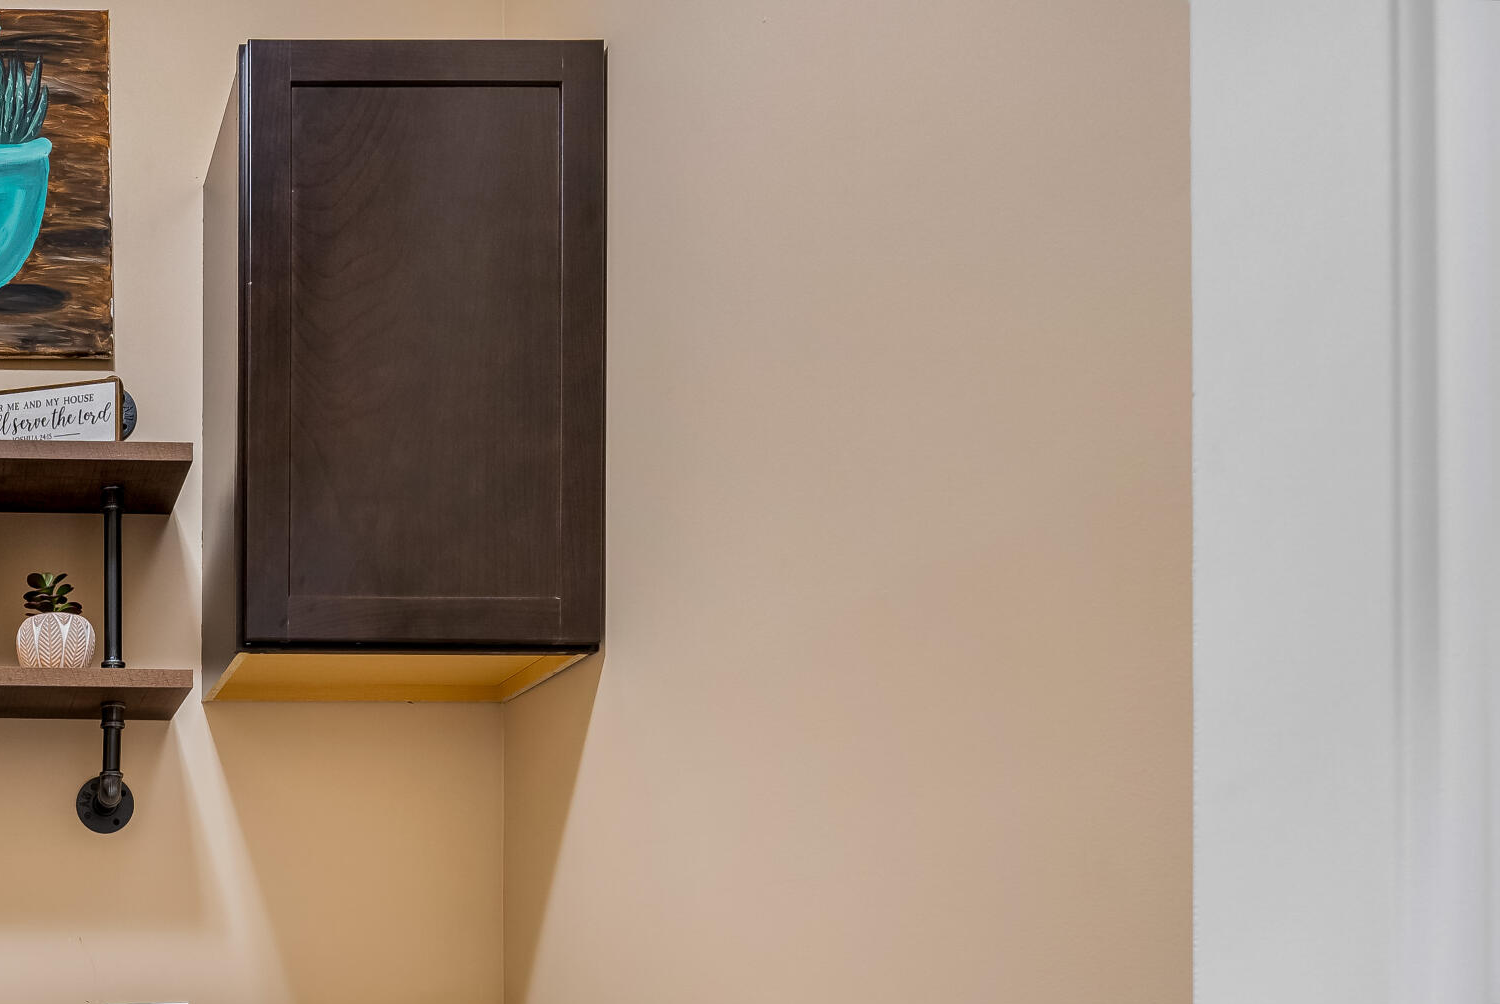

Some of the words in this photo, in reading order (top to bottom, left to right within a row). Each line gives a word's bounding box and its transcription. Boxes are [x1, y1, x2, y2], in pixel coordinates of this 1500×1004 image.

[7, 402, 20, 411] ME
[23, 400, 42, 409] AND
[45, 397, 60, 407] MY
[63, 393, 95, 405] HOUSE
[11, 416, 50, 436] serve
[51, 405, 77, 430] the
[78, 401, 112, 424] Lord
